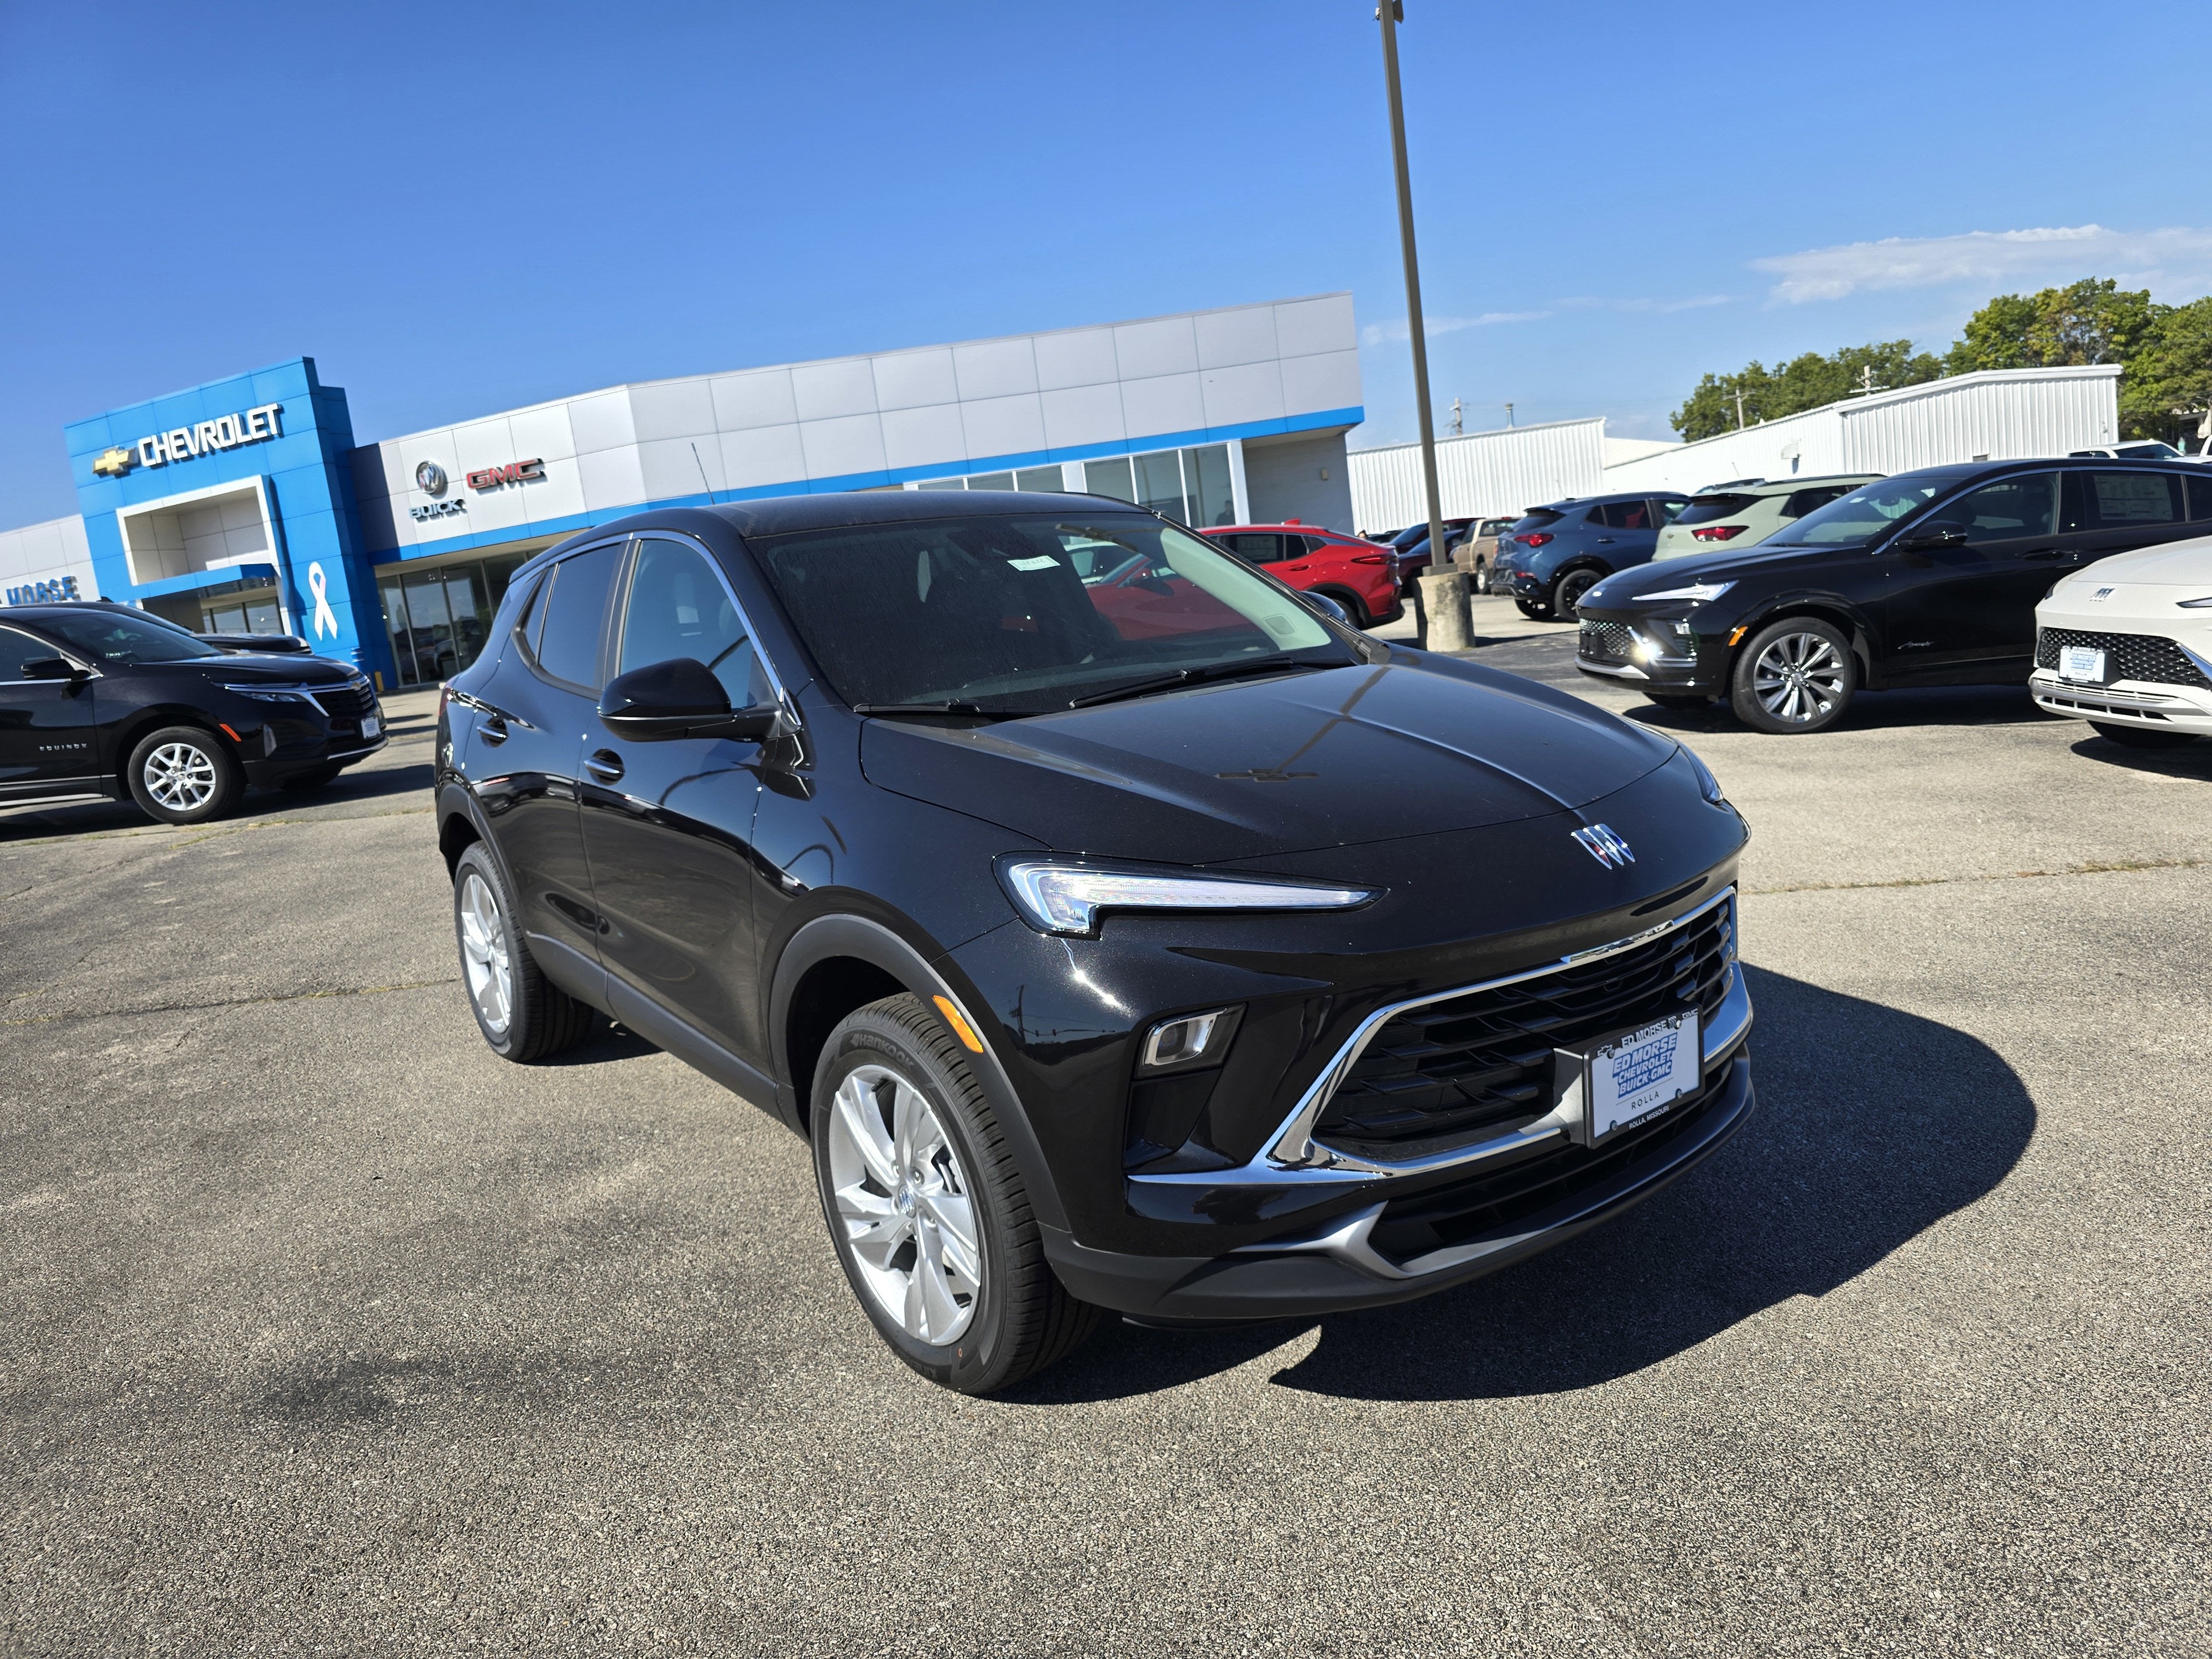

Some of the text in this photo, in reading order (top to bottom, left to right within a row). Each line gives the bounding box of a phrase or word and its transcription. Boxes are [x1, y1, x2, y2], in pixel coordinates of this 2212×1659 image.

[138, 403, 278, 467] CHEVROLET
[466, 459, 541, 489] GMC
[409, 500, 462, 519] BUICK
[6, 576, 75, 606] MORSE
[39, 743, 87, 751] EQUINOX
[1682, 1008, 1698, 1019] GMC
[1621, 1020, 1667, 1049] ED MORSE
[1613, 1033, 1677, 1074] ED MORSE
[1618, 1050, 1672, 1084] CHEVROLET
[1631, 1091, 1659, 1110] ROLLA
[1646, 1104, 1670, 1121] MISSOURI
